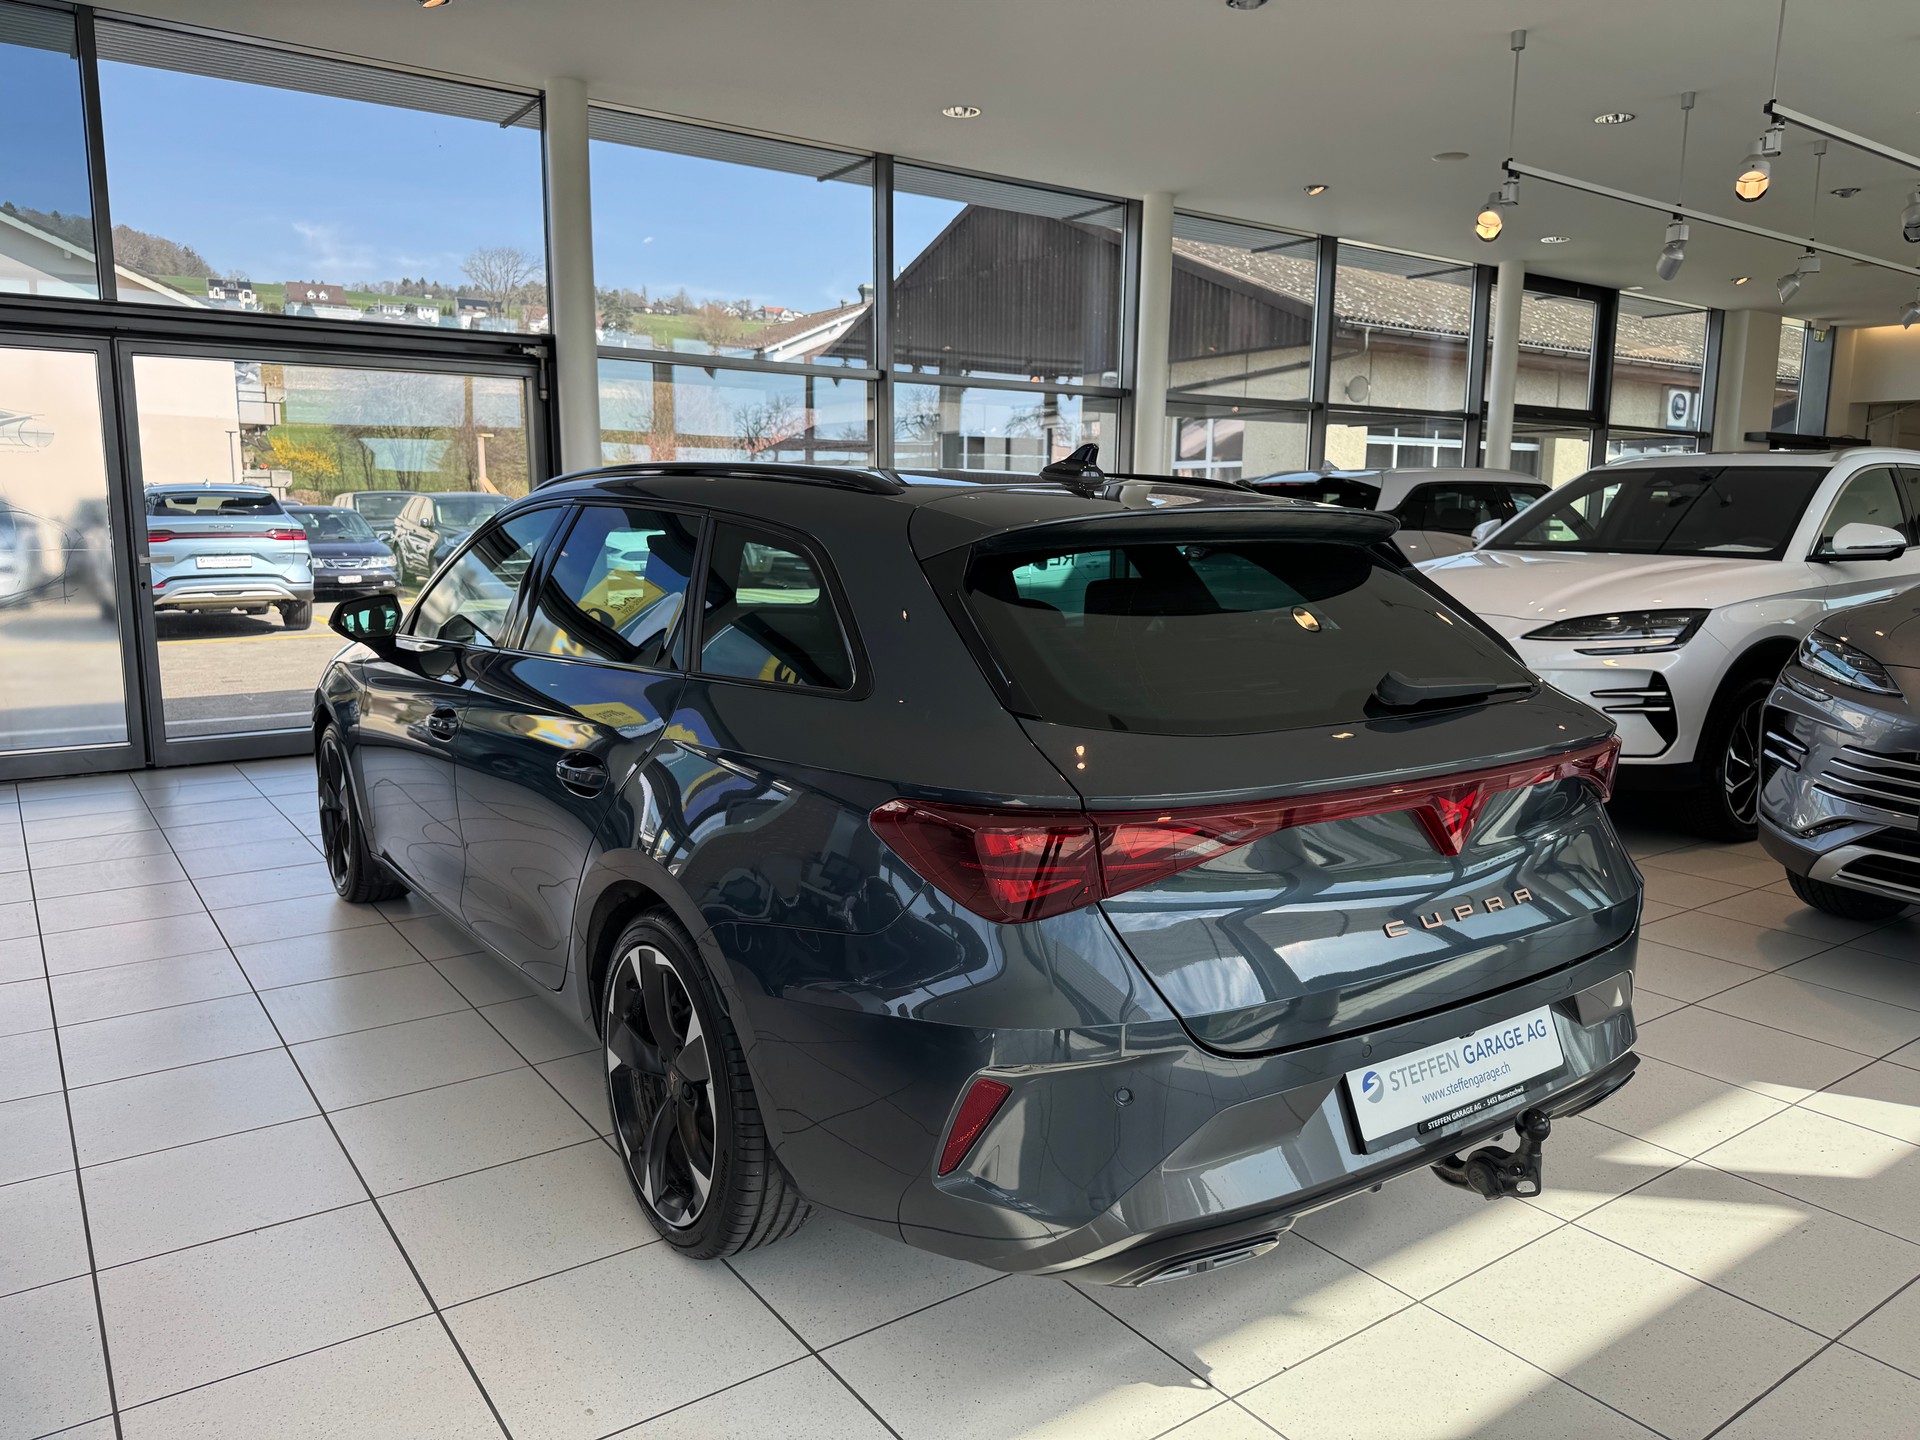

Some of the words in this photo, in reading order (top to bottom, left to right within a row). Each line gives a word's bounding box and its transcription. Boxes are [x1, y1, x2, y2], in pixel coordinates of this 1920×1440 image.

[1383, 888, 1533, 938] CUPRA
[1389, 1049, 1460, 1091] STEFFEN
[1463, 1027, 1524, 1064] GARAGE
[1527, 1019, 1547, 1042] AG
[1422, 1061, 1511, 1104] www.steffengarage.ch
[1427, 1114, 1452, 1130] STEFFEN
[1451, 1106, 1474, 1121] GARAGE
[1473, 1102, 1482, 1113] AG
